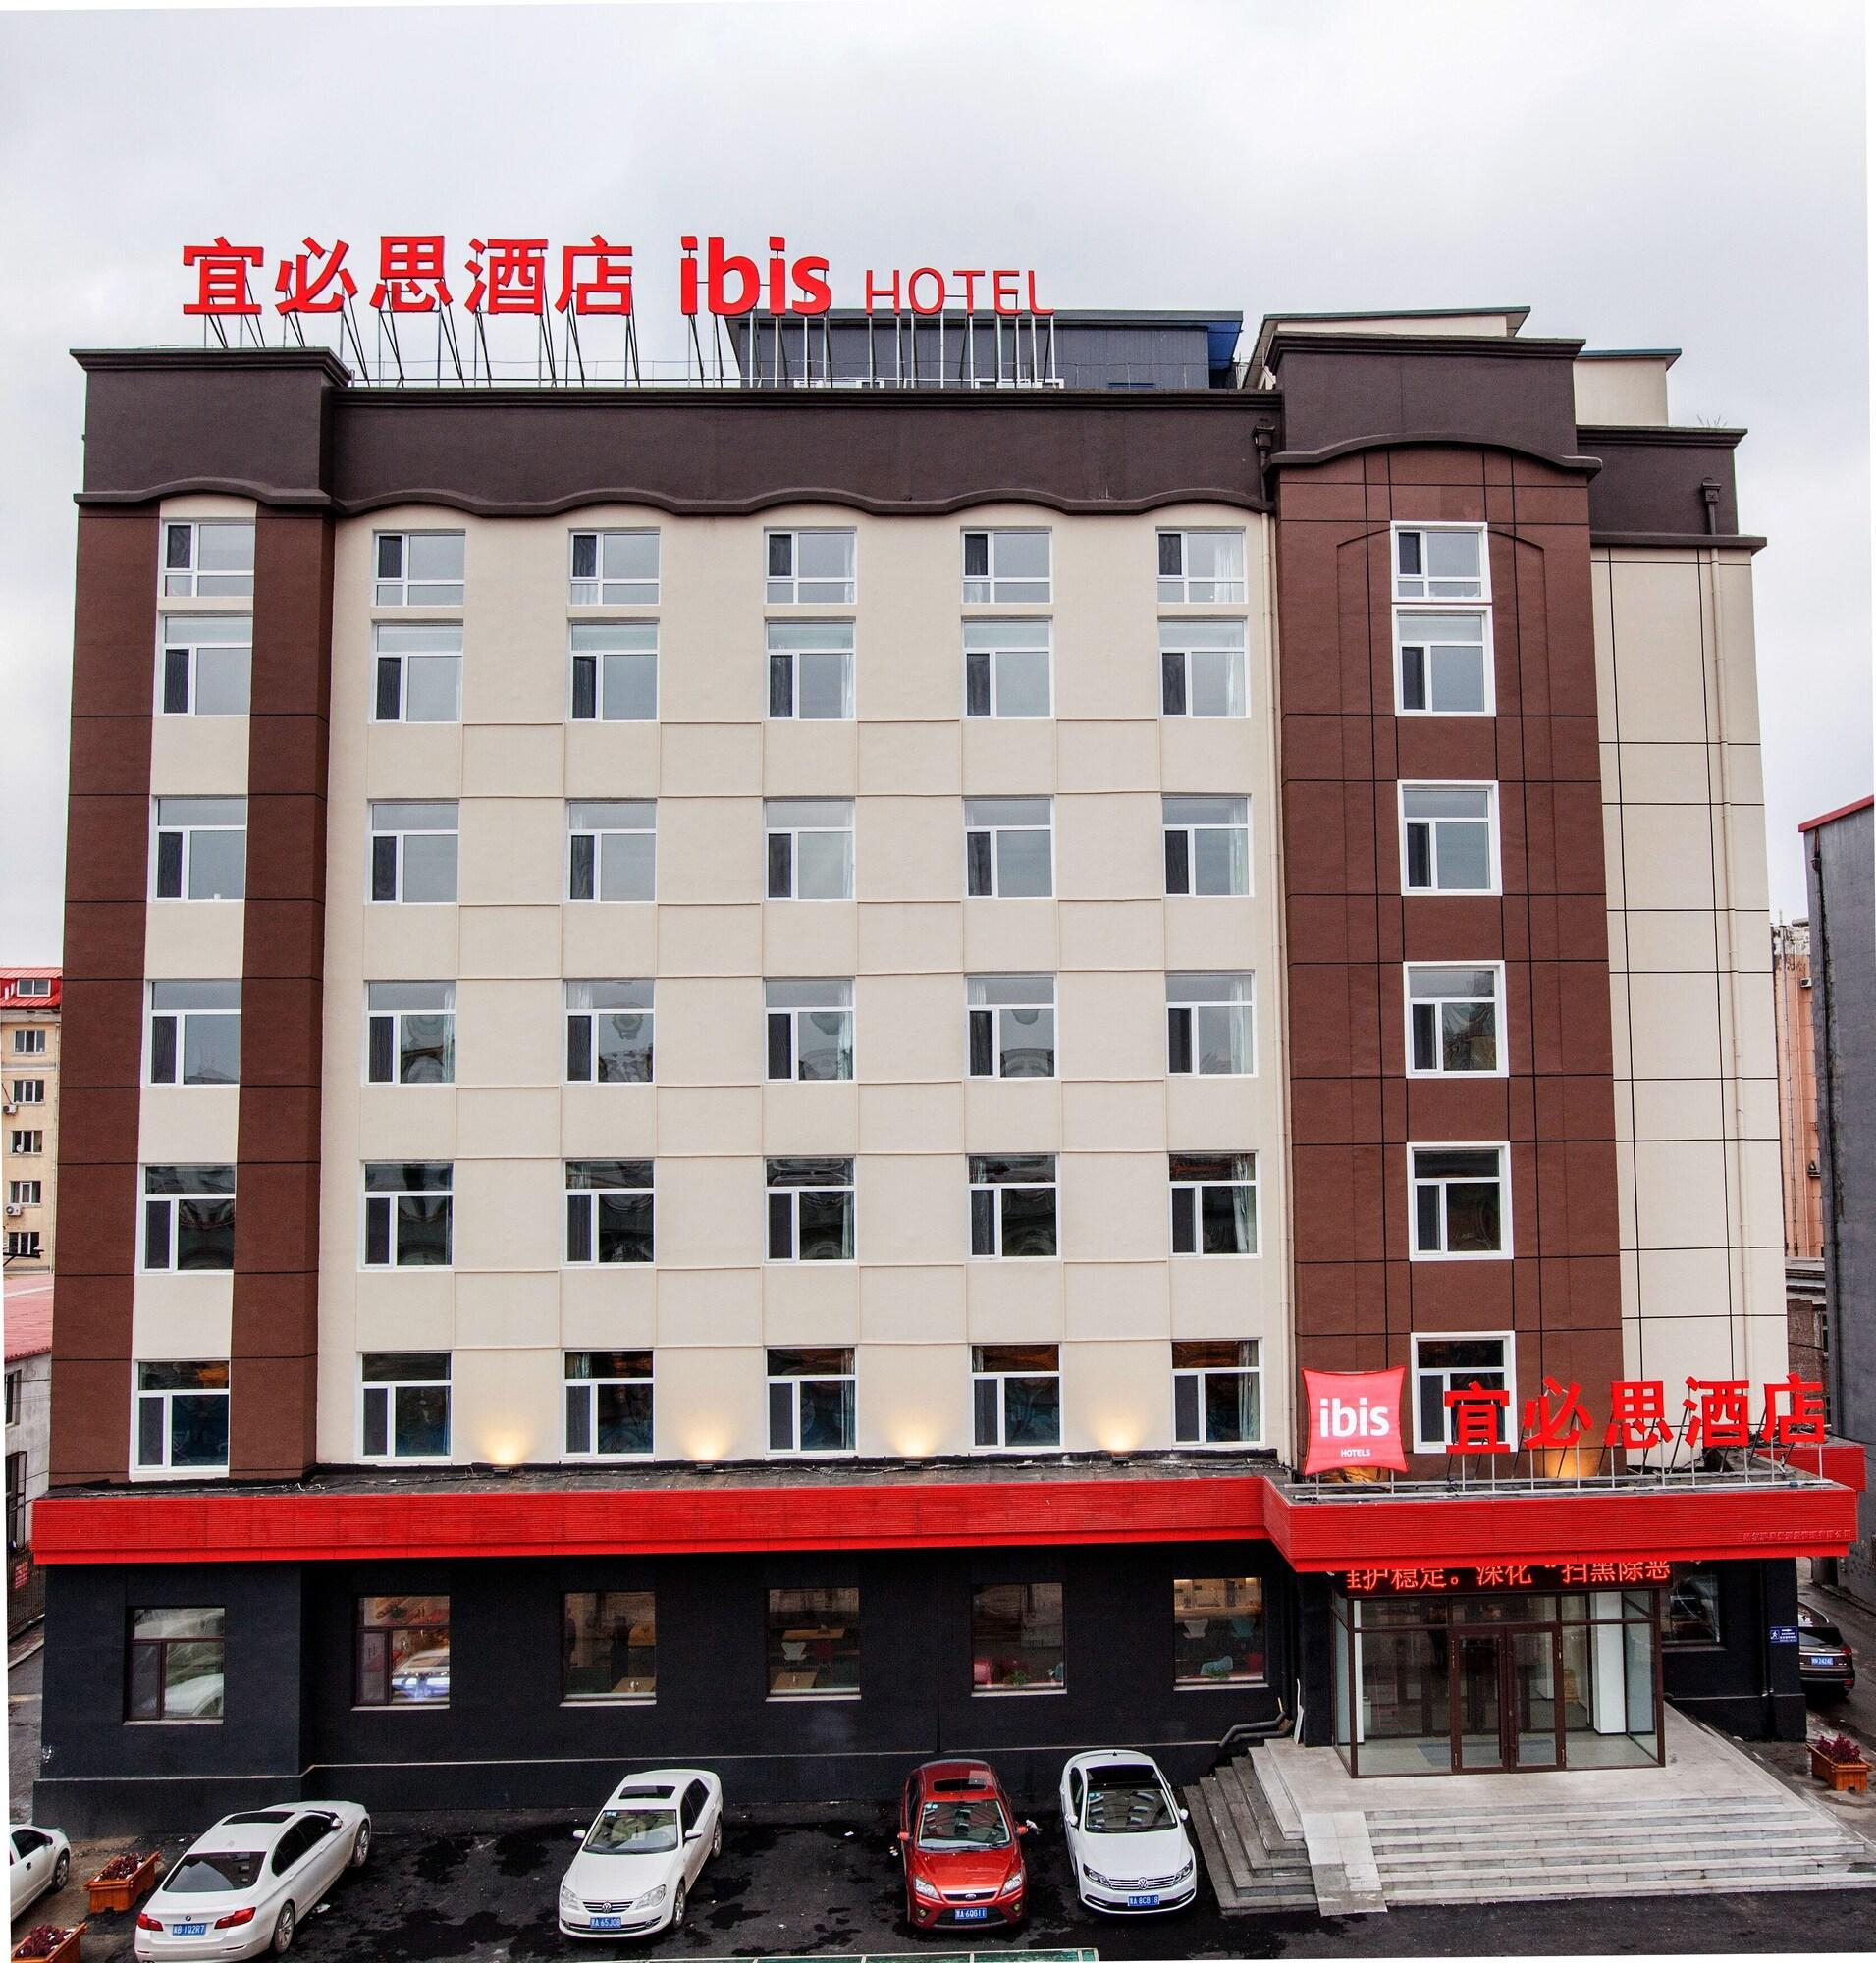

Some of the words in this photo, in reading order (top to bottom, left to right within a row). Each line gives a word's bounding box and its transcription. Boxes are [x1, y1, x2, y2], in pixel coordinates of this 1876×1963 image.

[183, 235, 633, 315] 宜必思酒店
[679, 236, 832, 315] ibis
[865, 268, 1054, 315] HOTEL
[1319, 1397, 1390, 1438] ibis
[1444, 1372, 1826, 1454] 宜必思酒店
[1340, 1449, 1371, 1458] HOTELS
